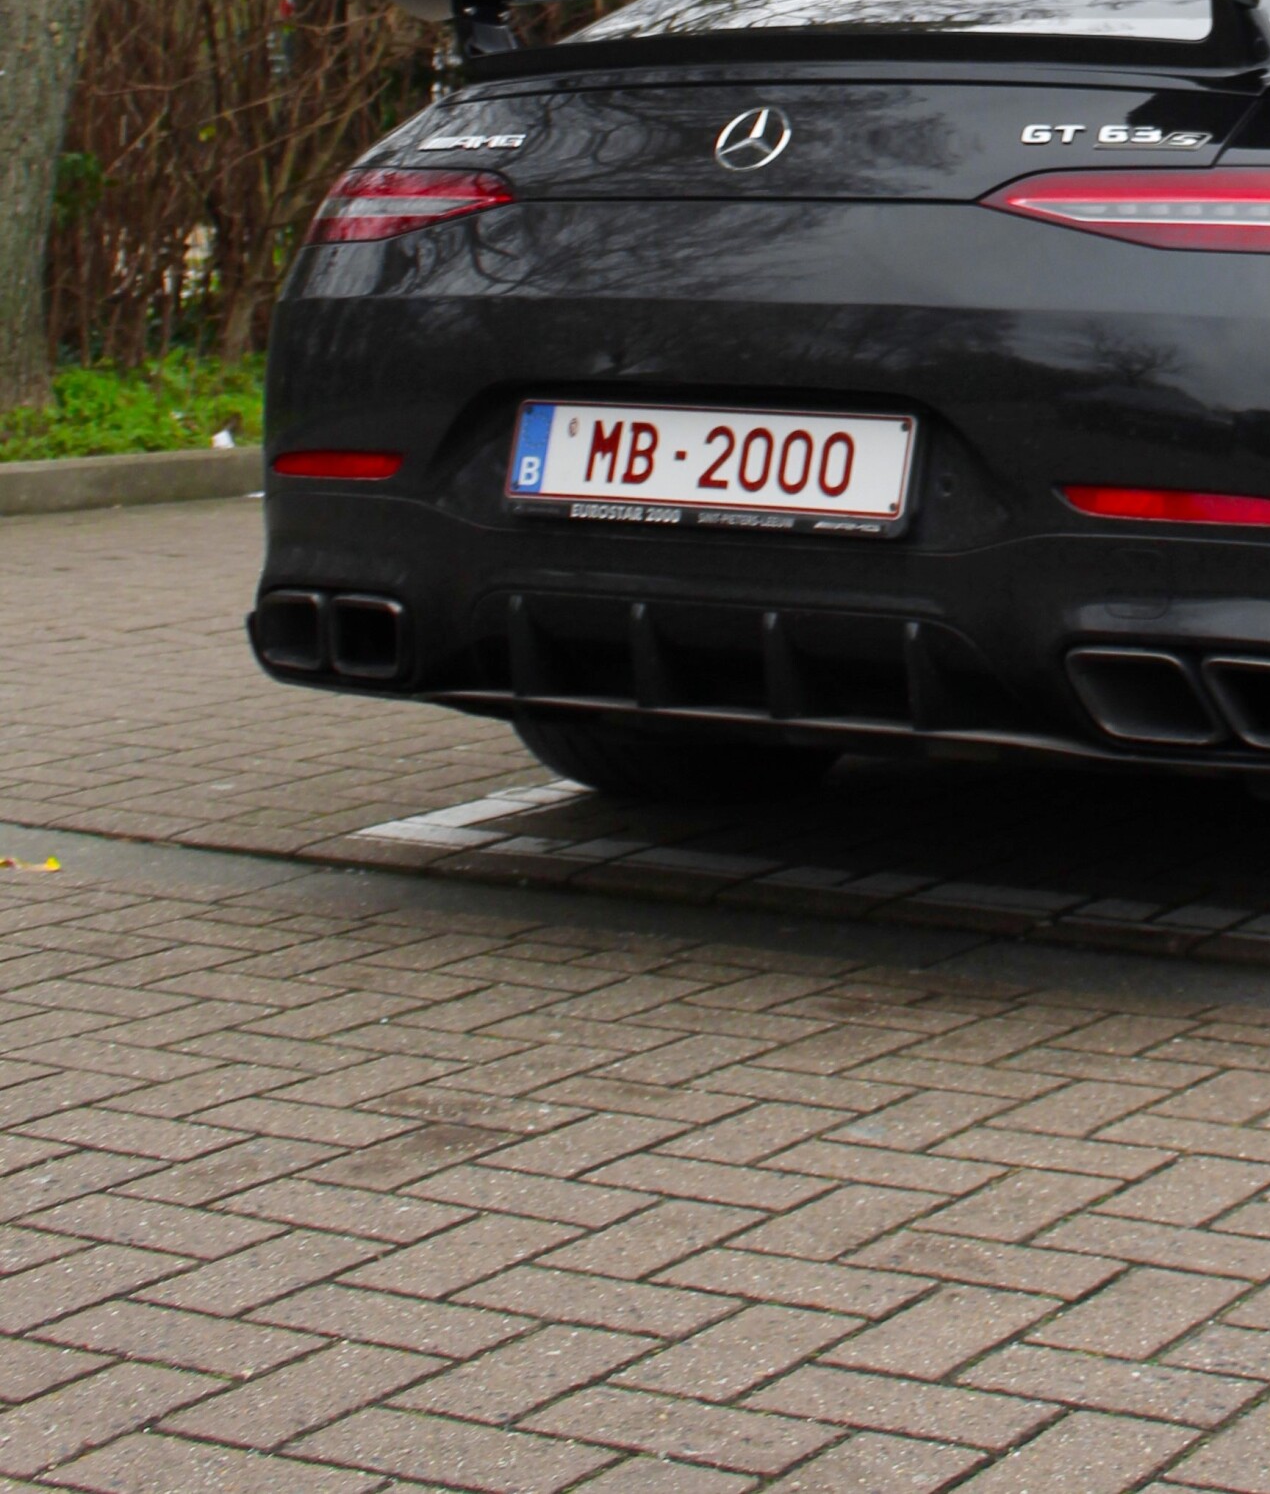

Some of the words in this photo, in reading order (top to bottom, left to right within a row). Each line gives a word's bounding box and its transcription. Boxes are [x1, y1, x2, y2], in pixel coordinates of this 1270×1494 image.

[450, 135, 526, 150] AMG
[1020, 124, 1086, 144] GT
[518, 455, 541, 486] B
[569, 503, 643, 521] EUROSTAR
[645, 508, 682, 523] 2000
